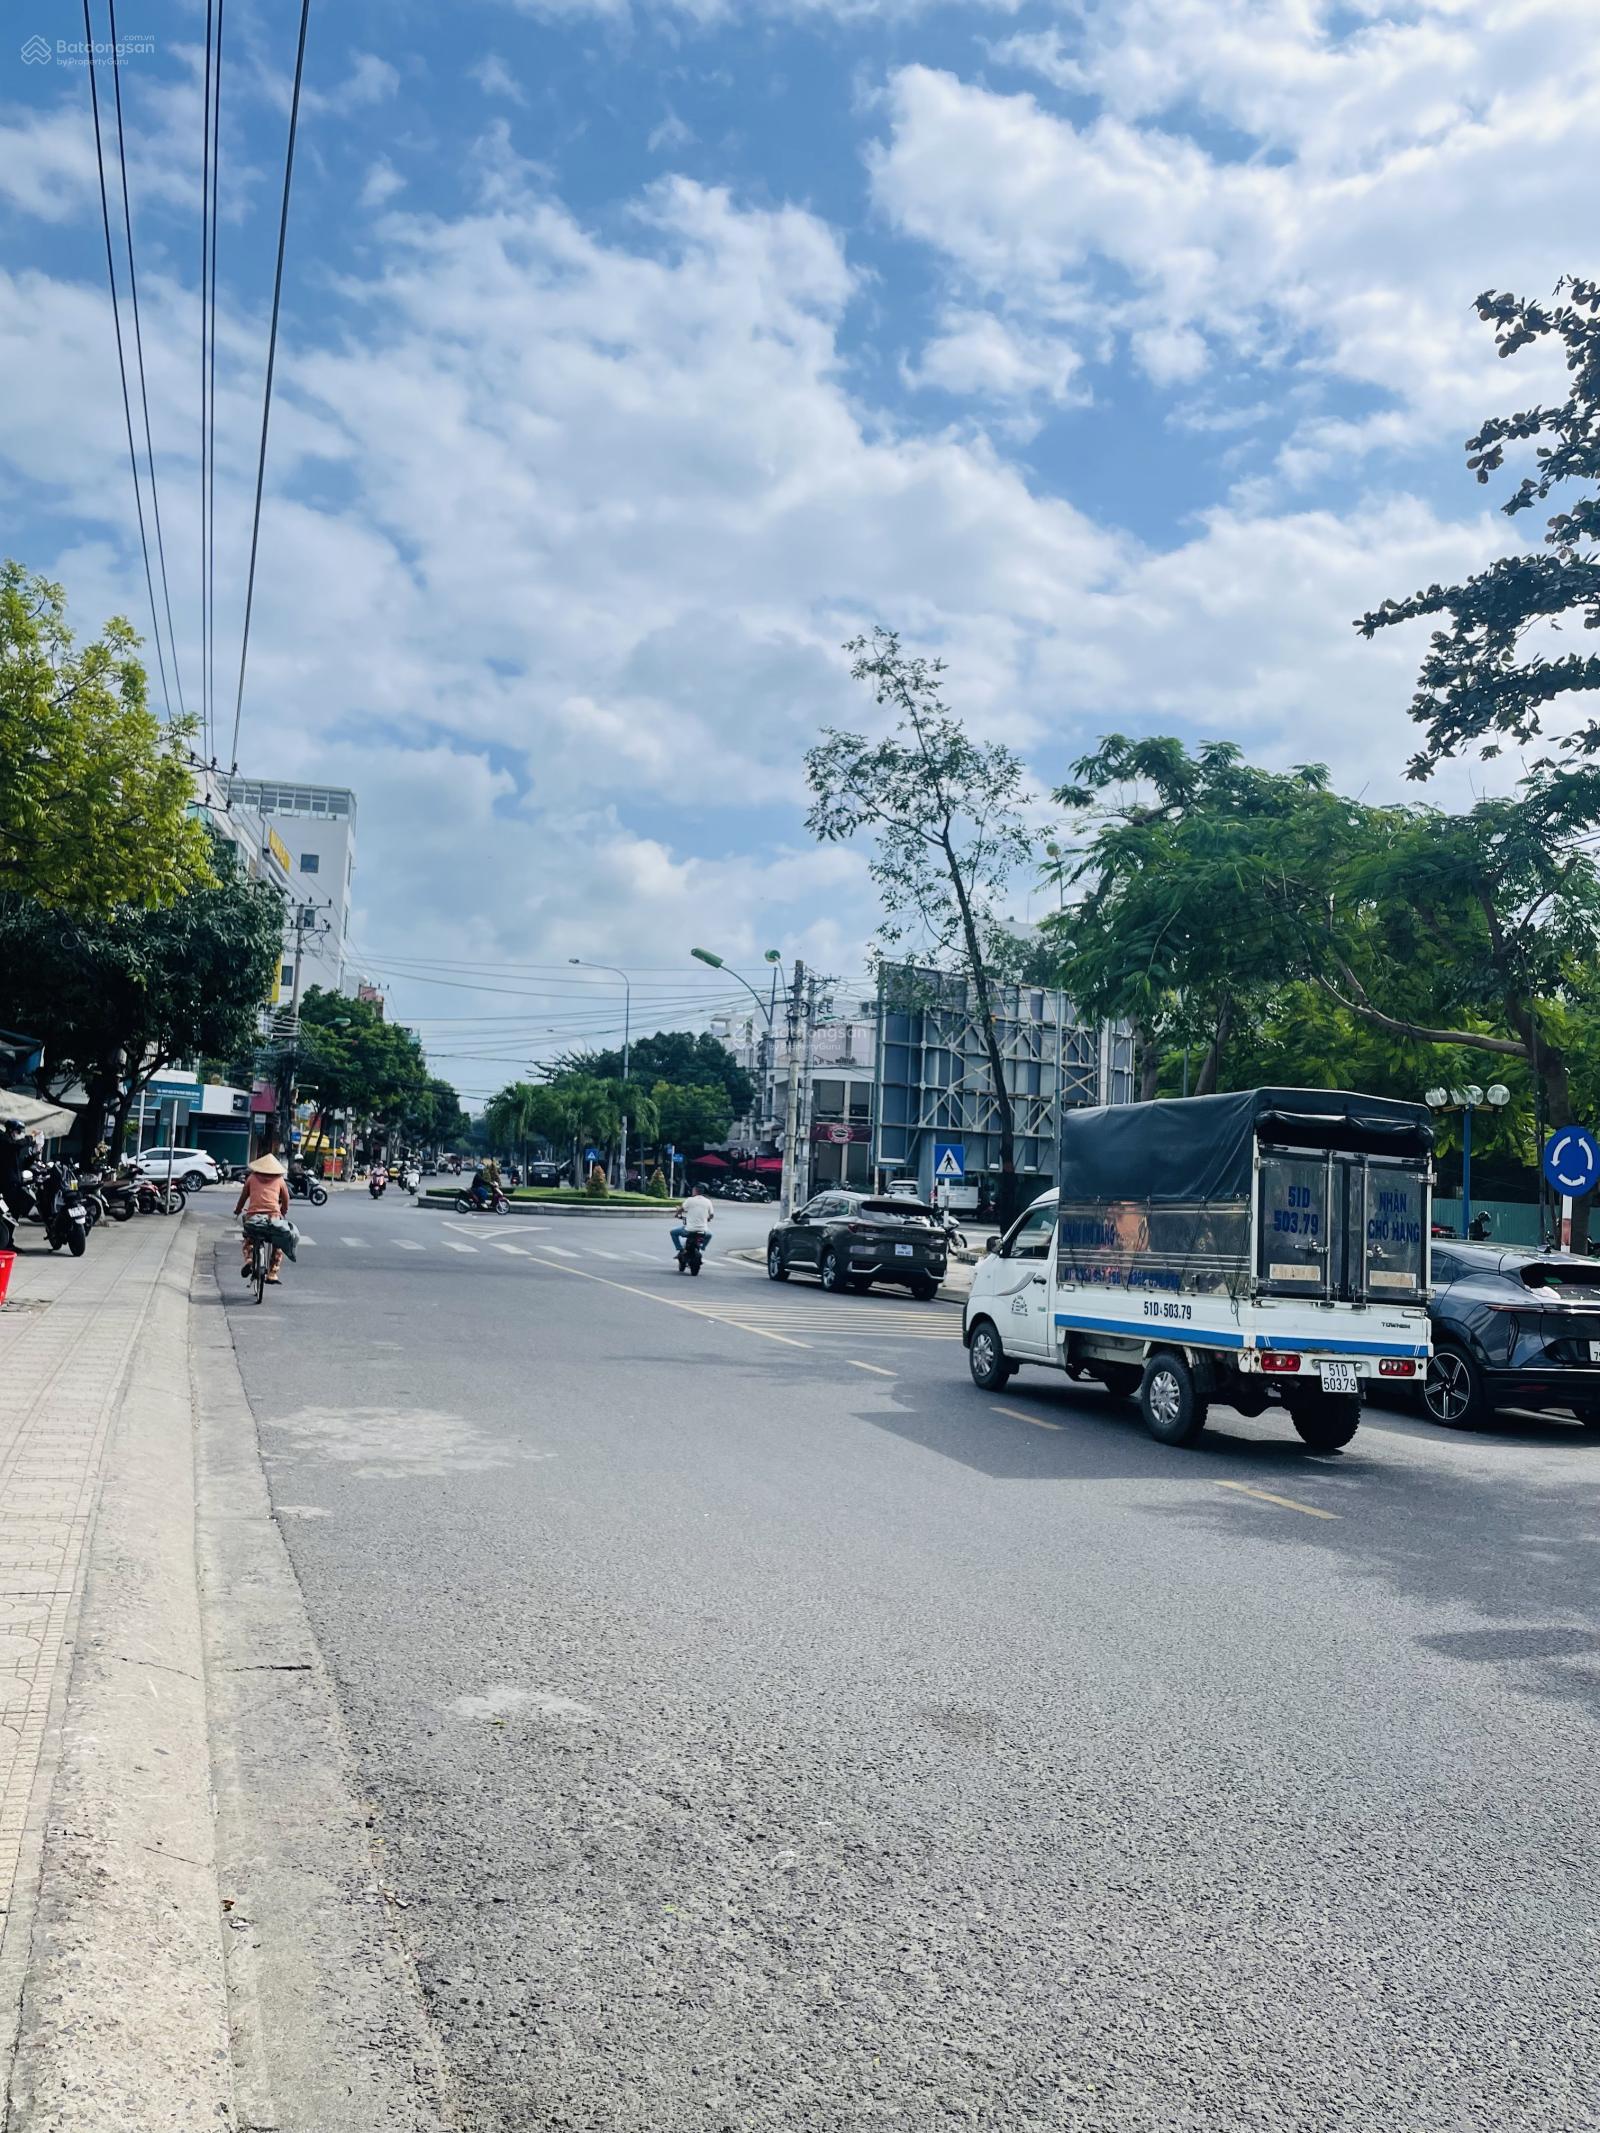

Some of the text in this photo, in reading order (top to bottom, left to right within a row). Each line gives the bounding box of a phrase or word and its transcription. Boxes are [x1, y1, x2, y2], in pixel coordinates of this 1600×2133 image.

[1288, 1186, 1311, 1209] 51D
[1273, 1210, 1319, 1236] 503.79
[1329, 1363, 1348, 1377] 51D
[1323, 1377, 1357, 1391] 503.79
